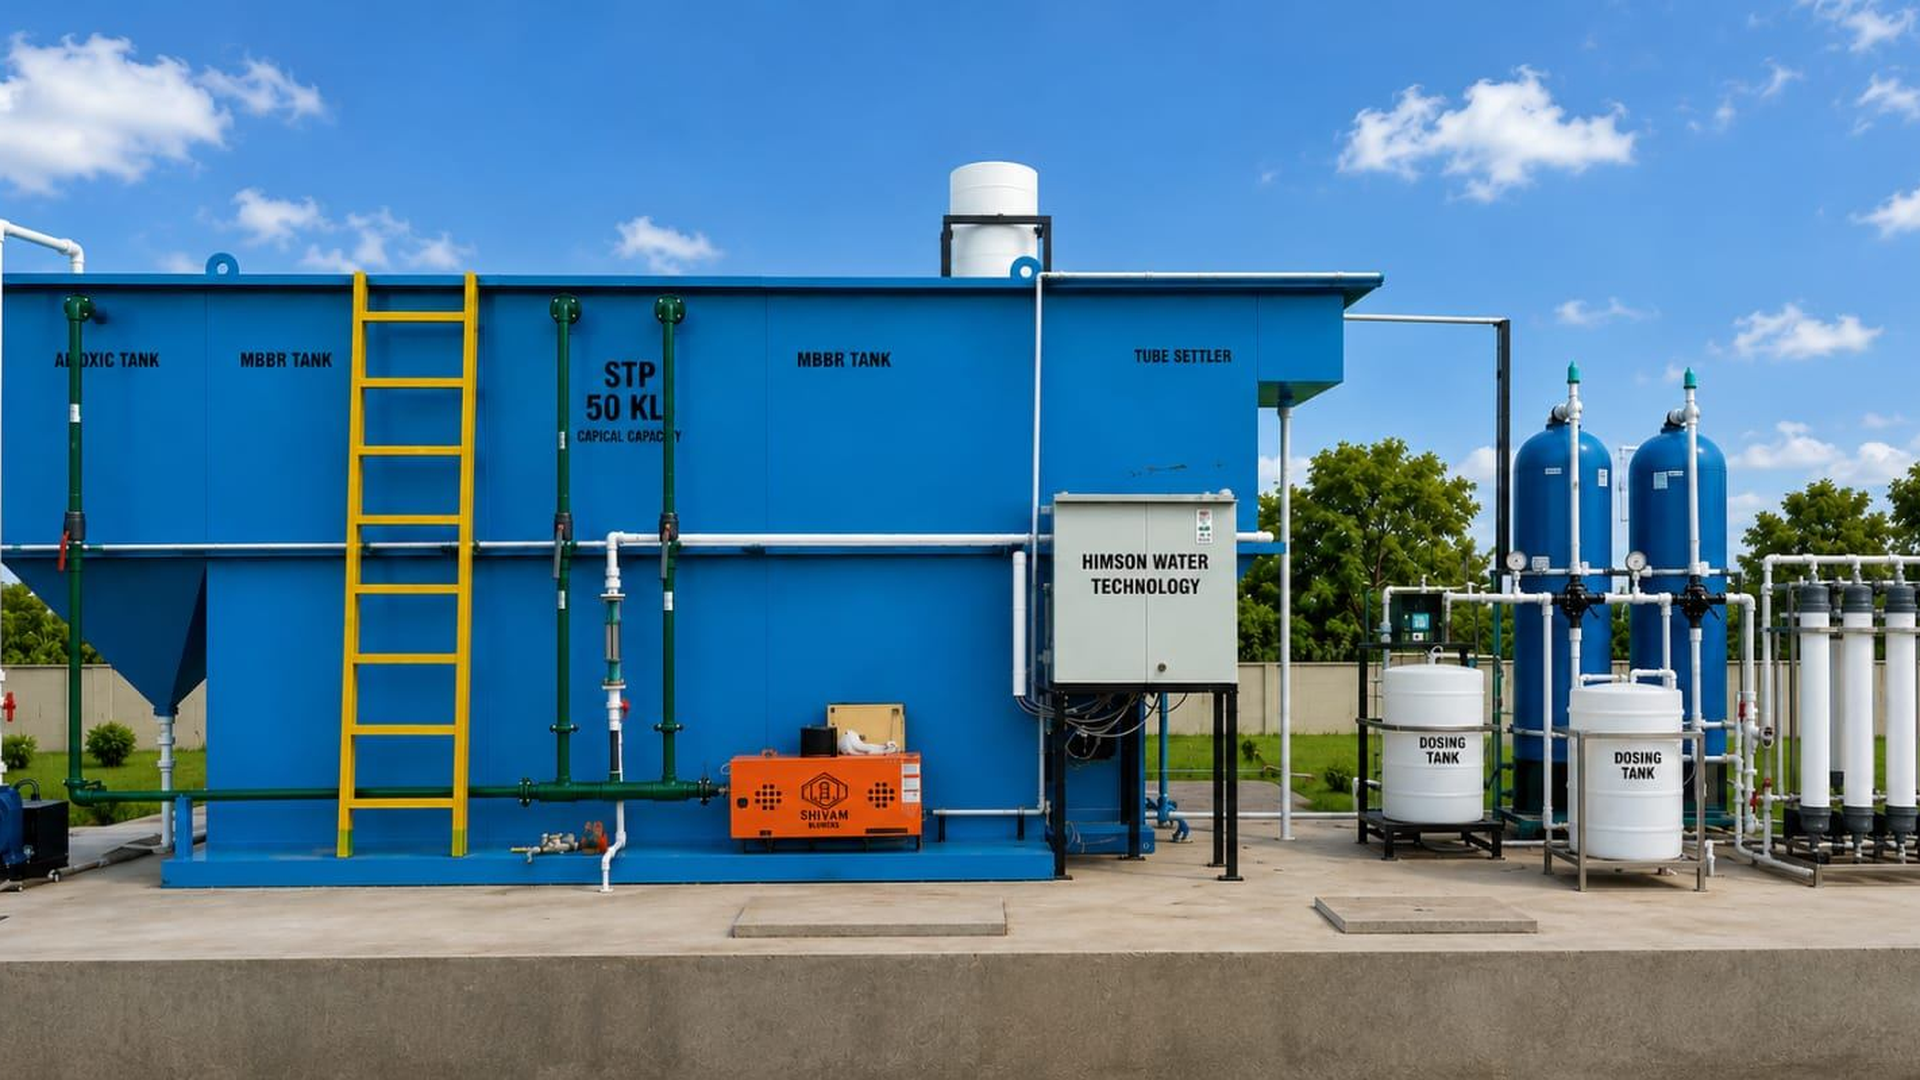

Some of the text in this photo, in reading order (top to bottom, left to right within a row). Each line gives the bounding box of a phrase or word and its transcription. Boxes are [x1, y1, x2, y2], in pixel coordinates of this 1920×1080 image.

[120, 352, 160, 368] TANK
[240, 352, 333, 368] MBBR TANK
[797, 352, 892, 368] MBBR TANK
[1134, 349, 1232, 363] TUBE SETTLER
[604, 361, 656, 388] STP
[586, 394, 663, 421] 50 KL
[627, 430, 682, 443] CAPACY
[1082, 554, 1209, 570] HIMSON WATER
[1091, 578, 1201, 595] TECHNOLOGY
[1419, 737, 1466, 749] DOSING
[1426, 752, 1460, 764] TANK
[1614, 752, 1662, 765] DOSING
[1622, 767, 1655, 780] TANK
[800, 810, 849, 821] SHIVAM
